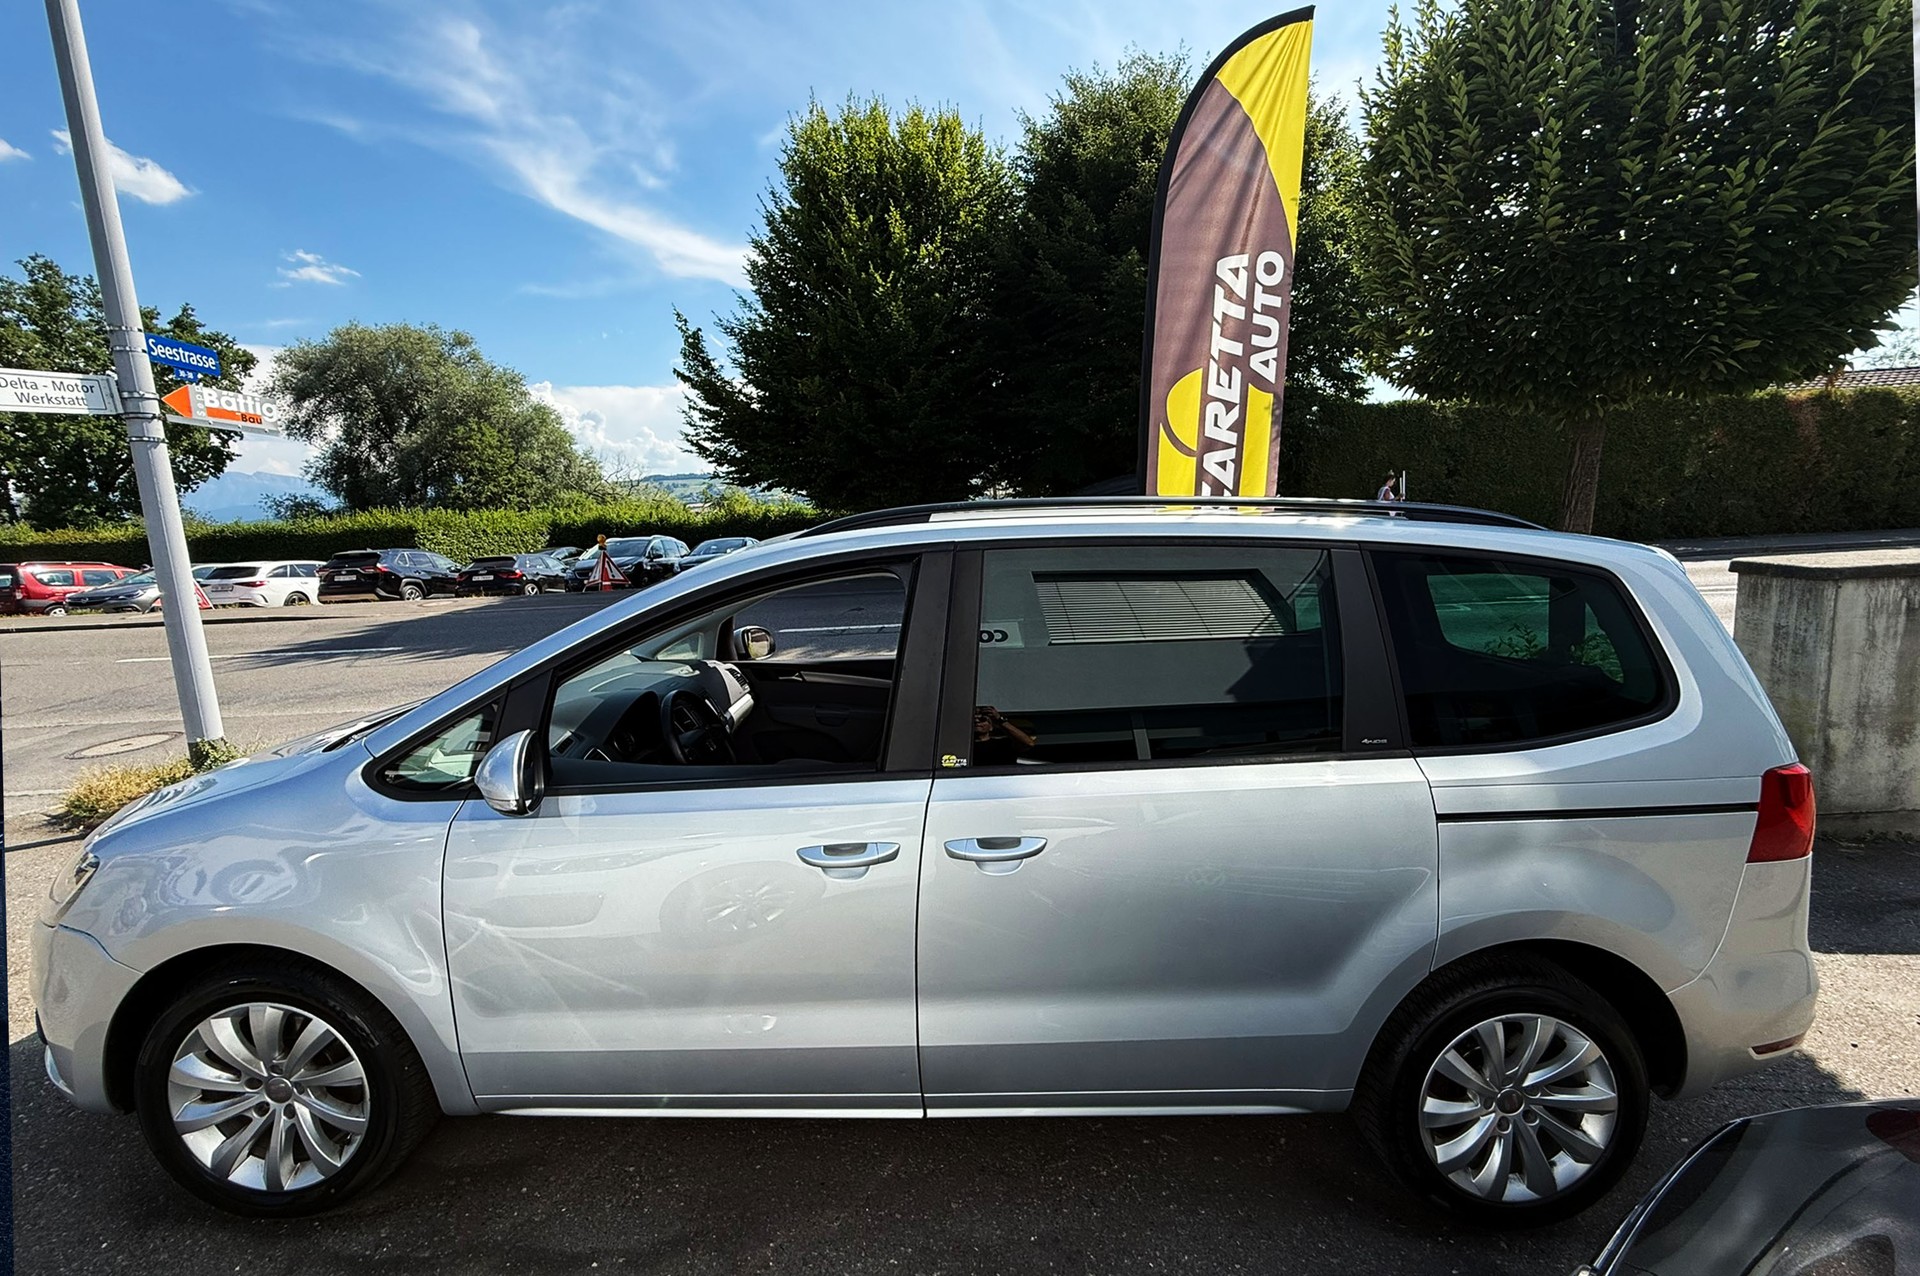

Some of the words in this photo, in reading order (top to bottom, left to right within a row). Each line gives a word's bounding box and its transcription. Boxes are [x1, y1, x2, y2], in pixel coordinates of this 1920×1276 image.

[1250, 250, 1285, 385] AUTO
[148, 338, 217, 370] Seestrasse
[14, 391, 88, 407] Werkstatt
[51, 380, 95, 394] Motor
[202, 386, 278, 423] Bättig
[240, 413, 263, 425] Bau
